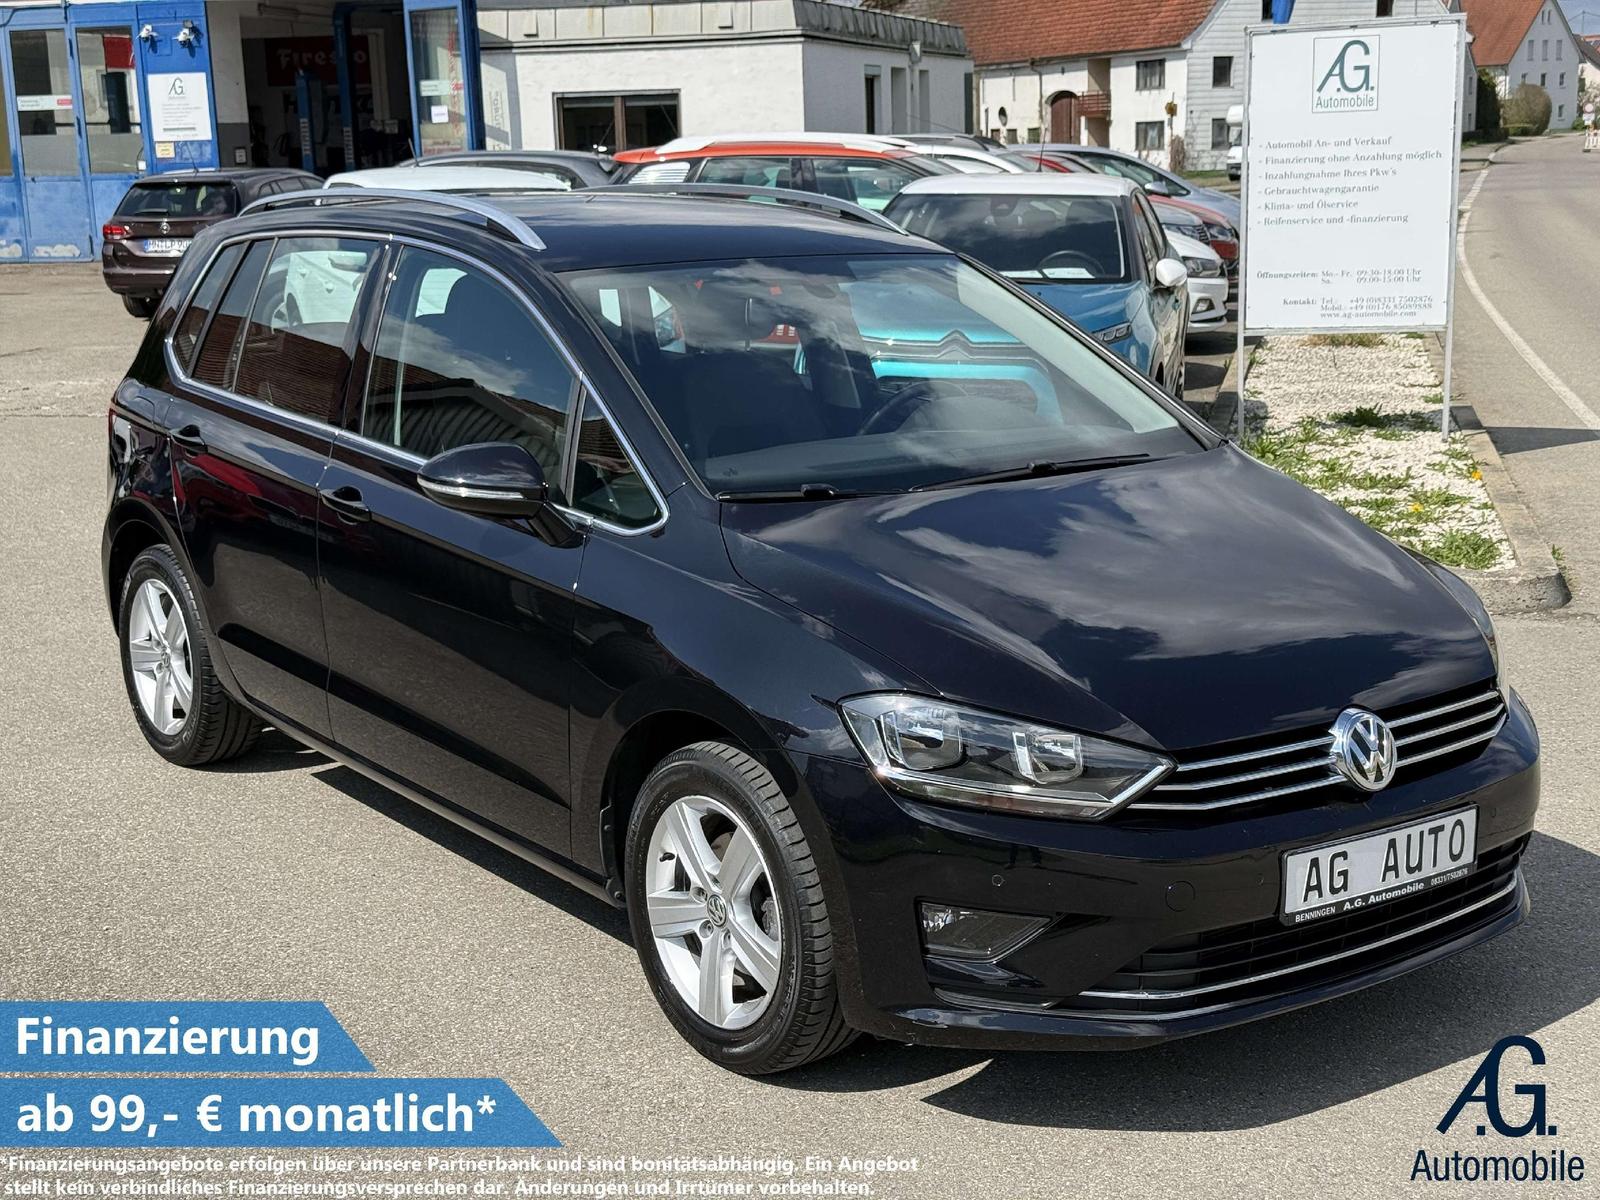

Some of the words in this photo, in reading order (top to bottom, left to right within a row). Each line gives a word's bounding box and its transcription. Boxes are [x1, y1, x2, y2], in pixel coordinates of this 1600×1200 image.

[1315, 95, 1374, 109] Automobile
[1265, 138, 1312, 150] Automobil
[1334, 138, 1351, 147] und
[1354, 136, 1393, 146] Verkauf
[1265, 155, 1325, 165] Finanzierung
[1327, 154, 1350, 163] ohne
[1353, 151, 1403, 162] Anzahlung
[1405, 150, 1443, 161] möglich
[1265, 169, 1341, 181] Inzahlungnahme
[1343, 169, 1367, 178] Ihres
[1264, 184, 1379, 196] Gebrauchtwagengarantie
[1297, 201, 1314, 210] und
[1317, 199, 1359, 209] Ölservice
[1264, 216, 1323, 226] Reifenservice
[1326, 215, 1344, 224] und
[1347, 213, 1409, 225] -finanzierung
[1257, 270, 1318, 280] Öffnungszeiten:
[1283, 298, 1317, 306] Kontakt:
[1303, 850, 1349, 903] AG
[1381, 818, 1466, 883] AUTO
[1295, 906, 1336, 923] BENNINGEN
[1343, 898, 1366, 911] A.G.
[1369, 882, 1425, 904] Automobile
